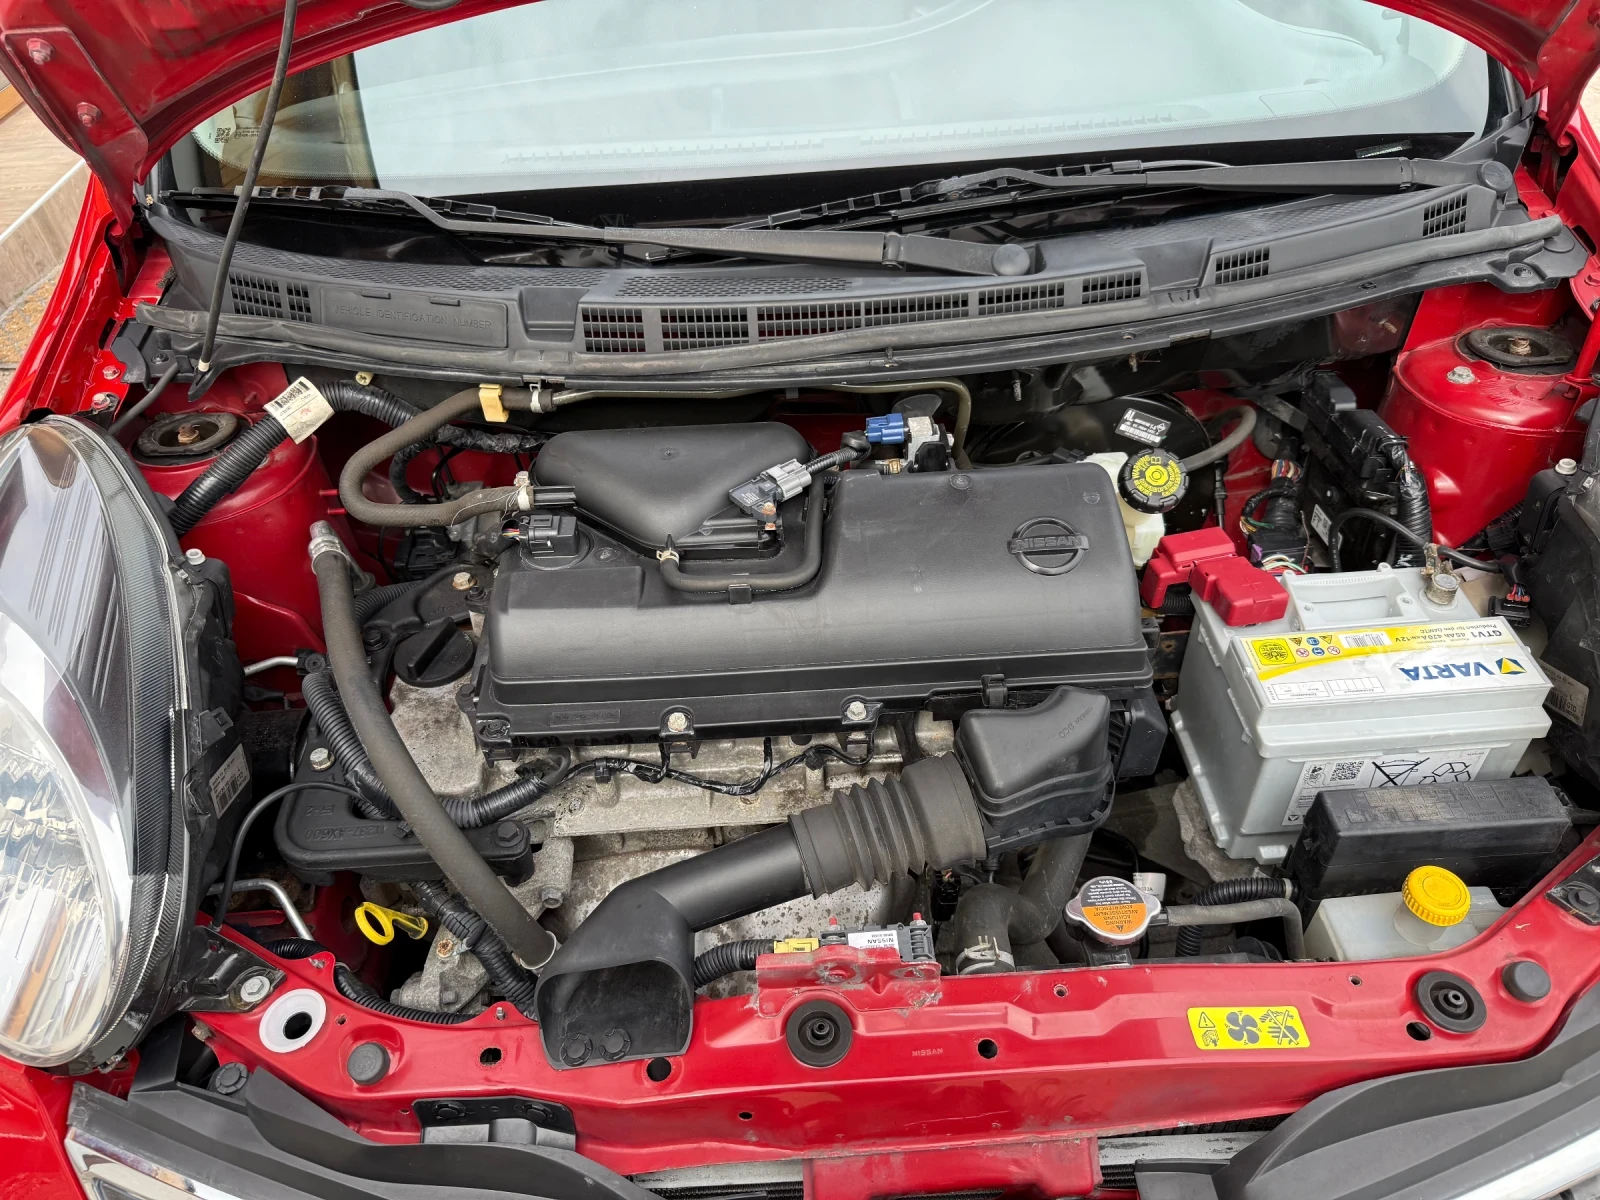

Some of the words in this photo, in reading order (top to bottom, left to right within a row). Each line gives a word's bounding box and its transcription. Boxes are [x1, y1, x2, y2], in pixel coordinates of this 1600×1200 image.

[334, 305, 371, 317] VEHICLE
[376, 309, 448, 325] IDENTIFICATION
[453, 317, 493, 330] NUMBER
[1016, 536, 1082, 550] NISSAN
[1398, 662, 1495, 681] VARTA
[912, 1048, 943, 1056] NISSAN
